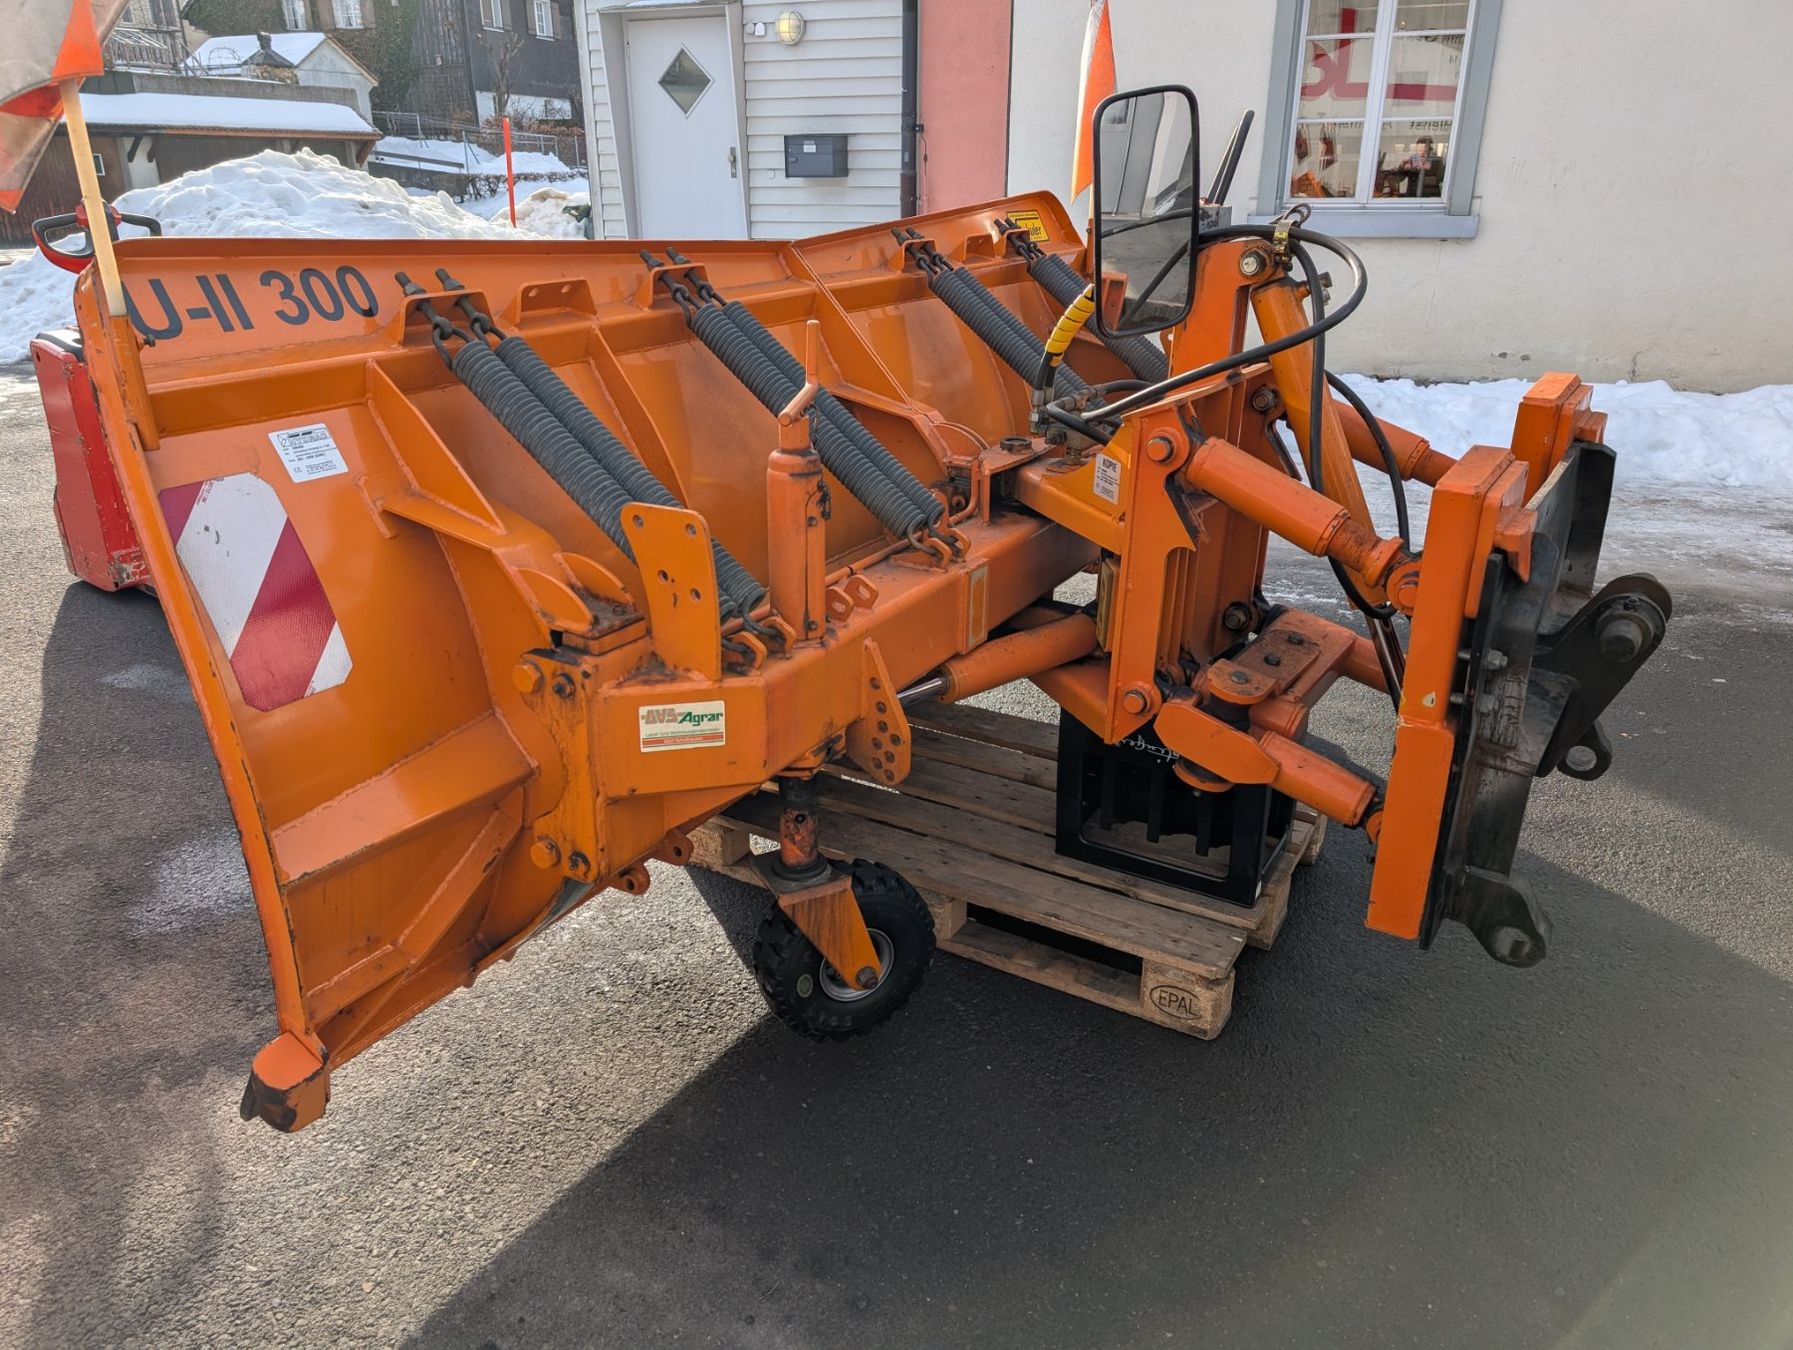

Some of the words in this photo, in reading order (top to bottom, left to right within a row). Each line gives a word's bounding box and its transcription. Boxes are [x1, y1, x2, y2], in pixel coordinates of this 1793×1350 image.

[260, 265, 379, 326] 300
[678, 711, 724, 727] Agrar
[1158, 989, 1198, 1017] EPAL
